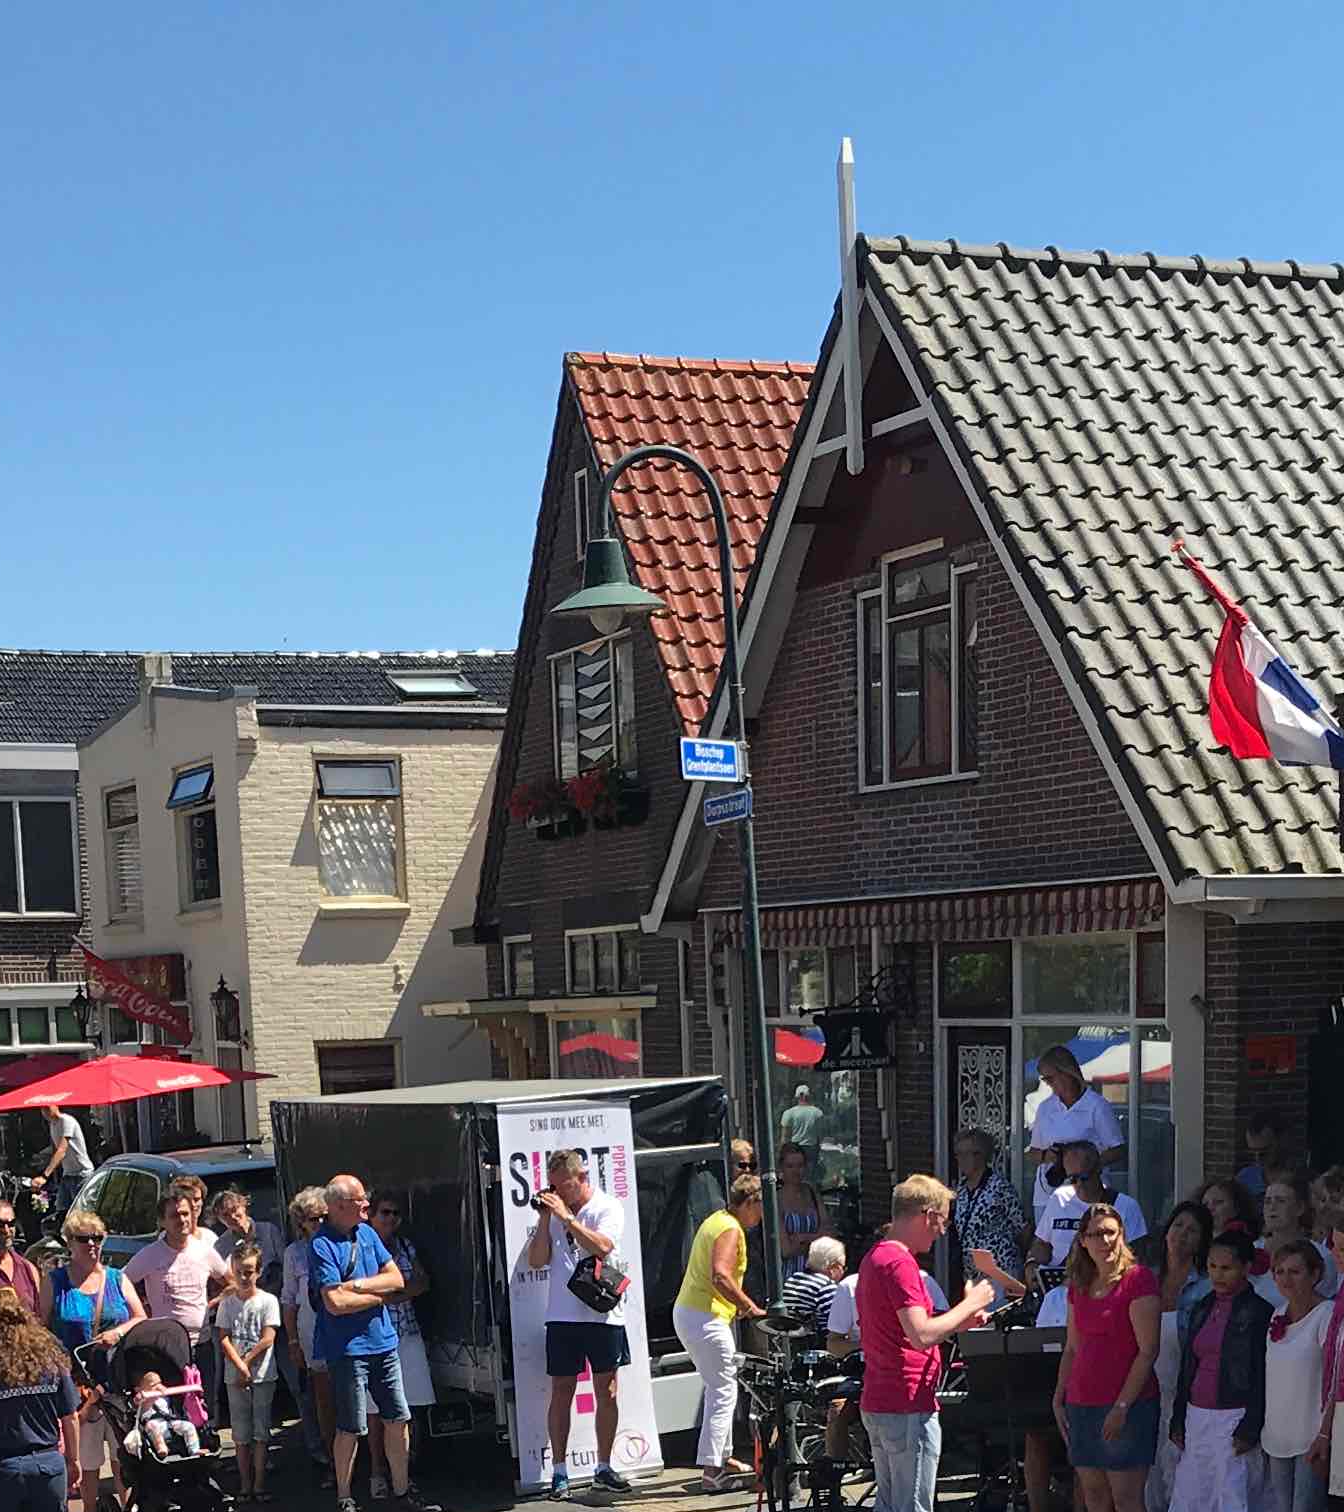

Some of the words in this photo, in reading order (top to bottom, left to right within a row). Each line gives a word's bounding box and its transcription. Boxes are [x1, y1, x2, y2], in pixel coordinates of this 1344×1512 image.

[529, 1119, 549, 1132] SING
[551, 1117, 567, 1131] OOK
[568, 1116, 587, 1130] MEE
[588, 1114, 605, 1128] MET
[611, 1144, 630, 1201] POPKOOR
